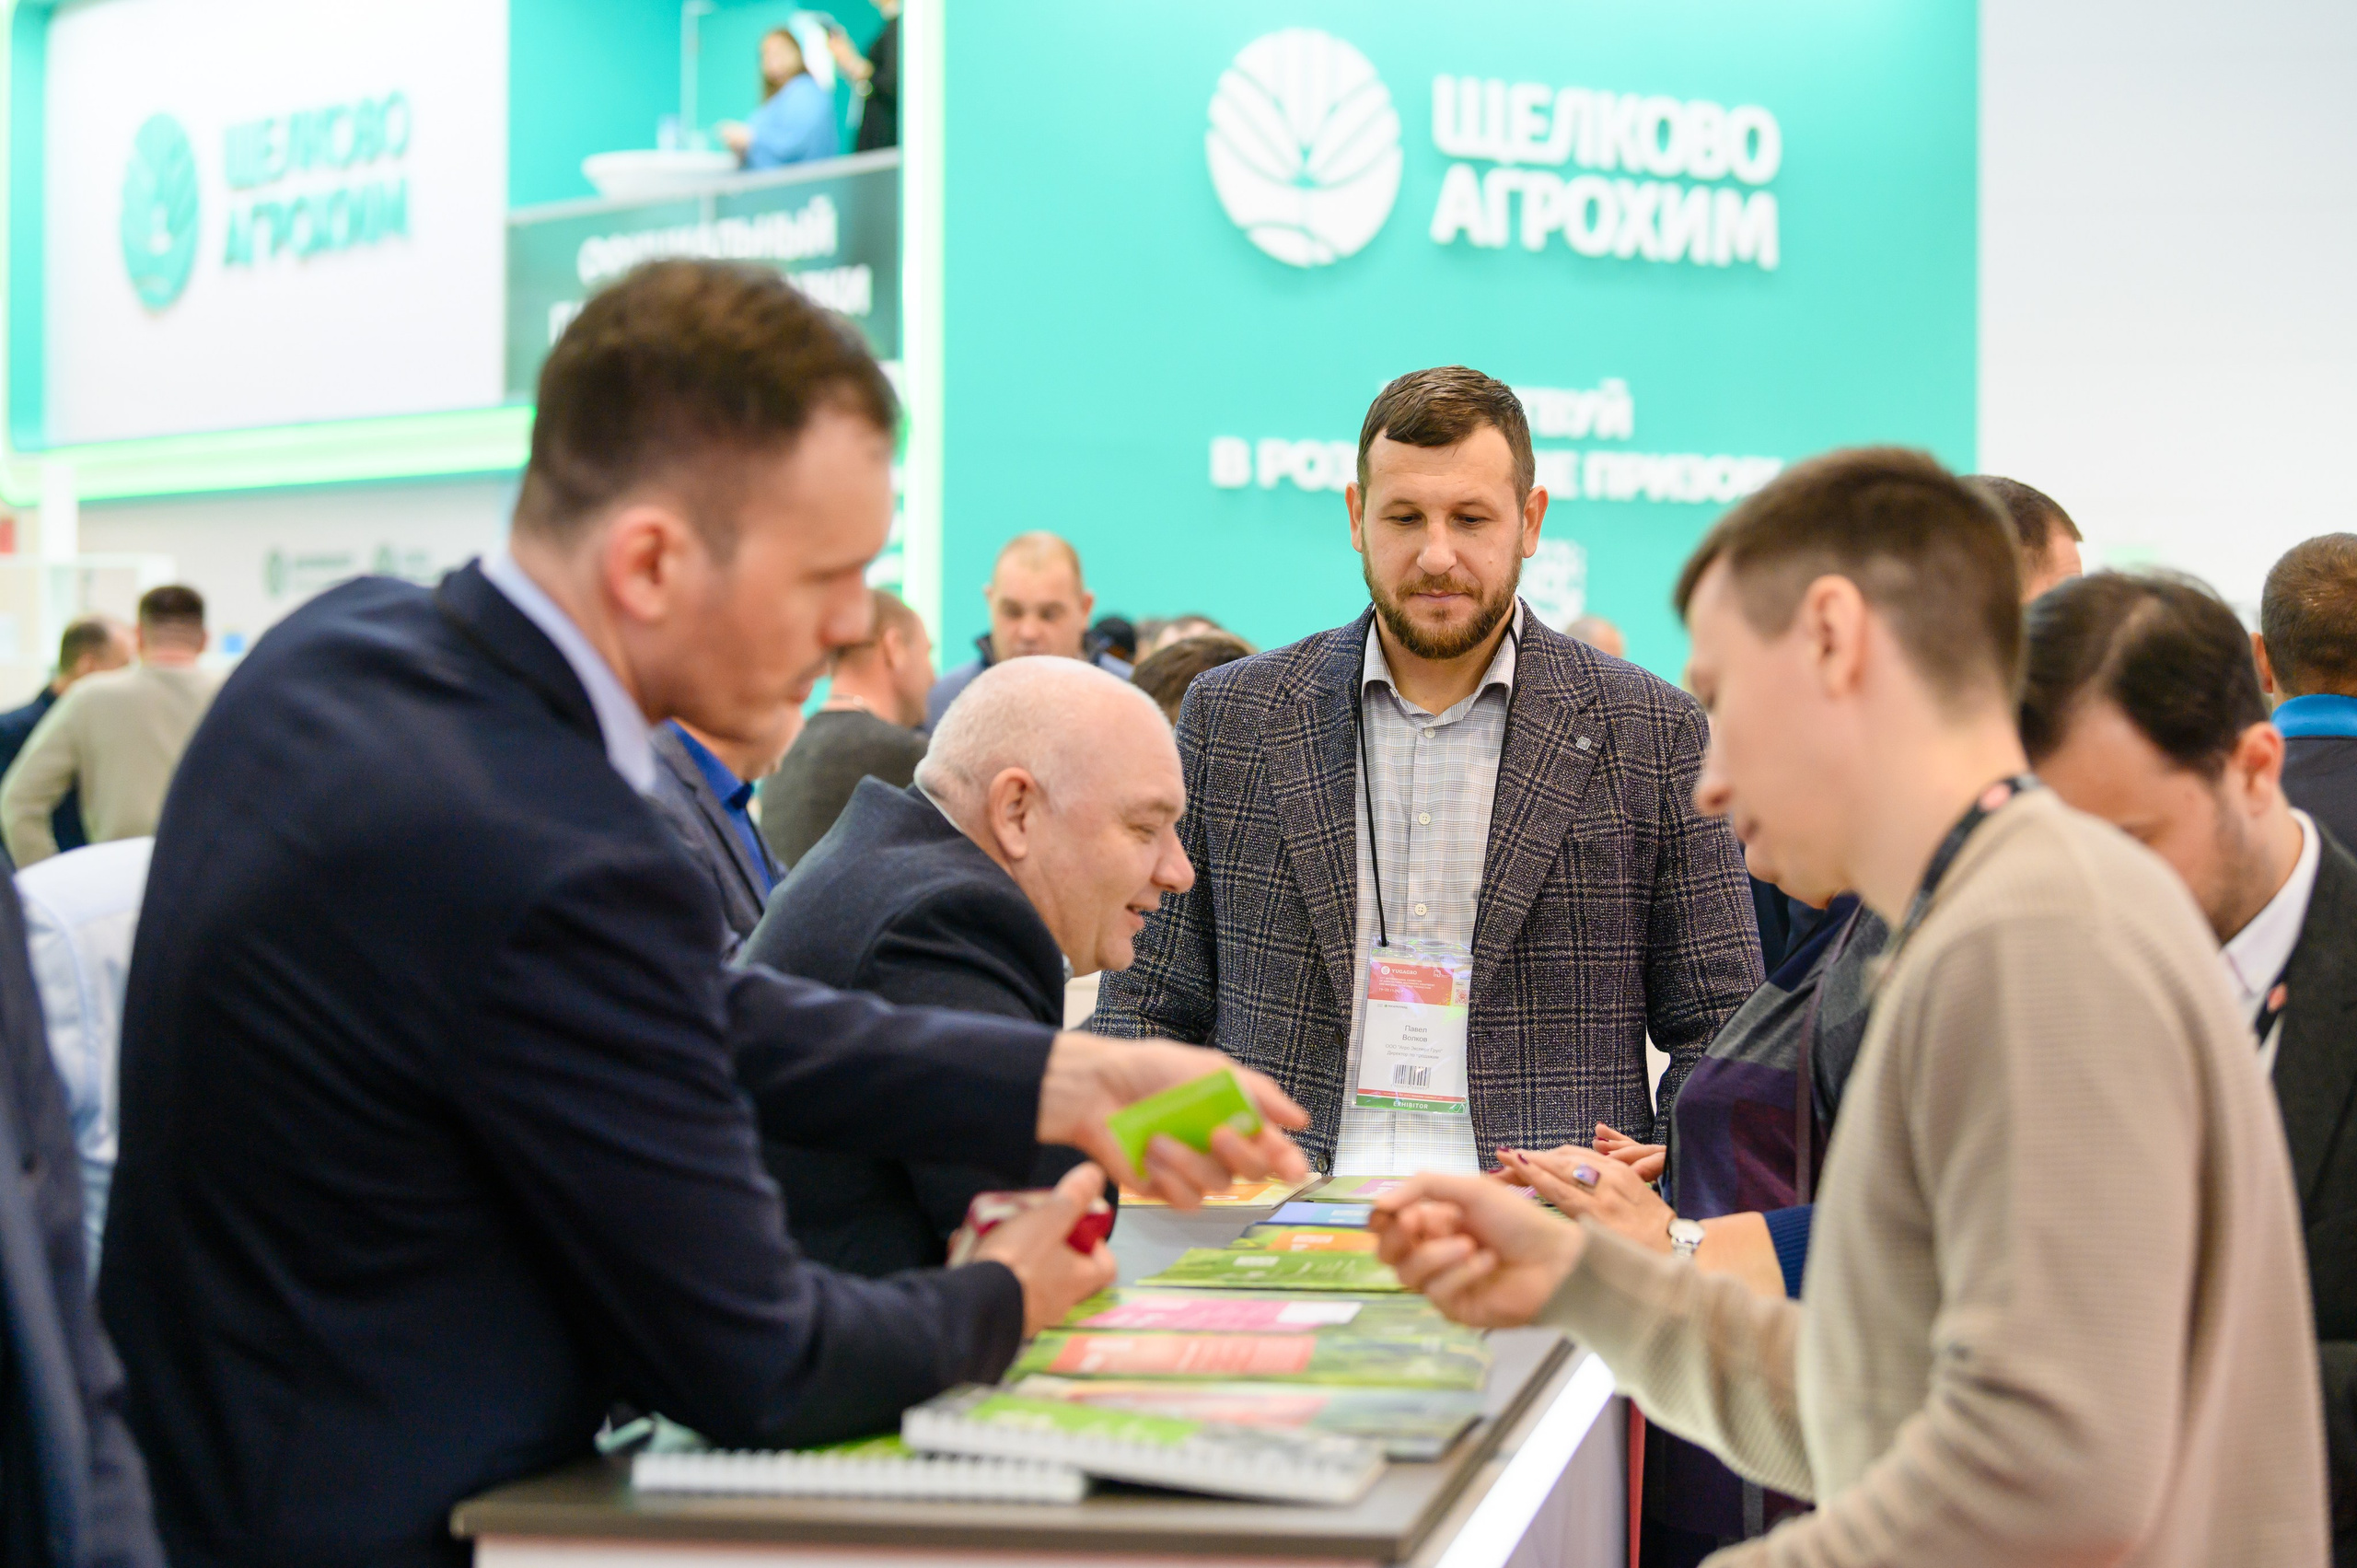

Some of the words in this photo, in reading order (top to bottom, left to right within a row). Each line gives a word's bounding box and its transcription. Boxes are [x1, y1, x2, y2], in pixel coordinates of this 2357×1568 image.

[1432, 74, 1782, 185] ЩЕЛКОВО
[1430, 163, 1780, 271] АГРОХИМ
[1404, 1025, 1427, 1033] Павел
[1402, 1034, 1428, 1042] Волков
[1393, 1101, 1429, 1109] EXHIBITOR
